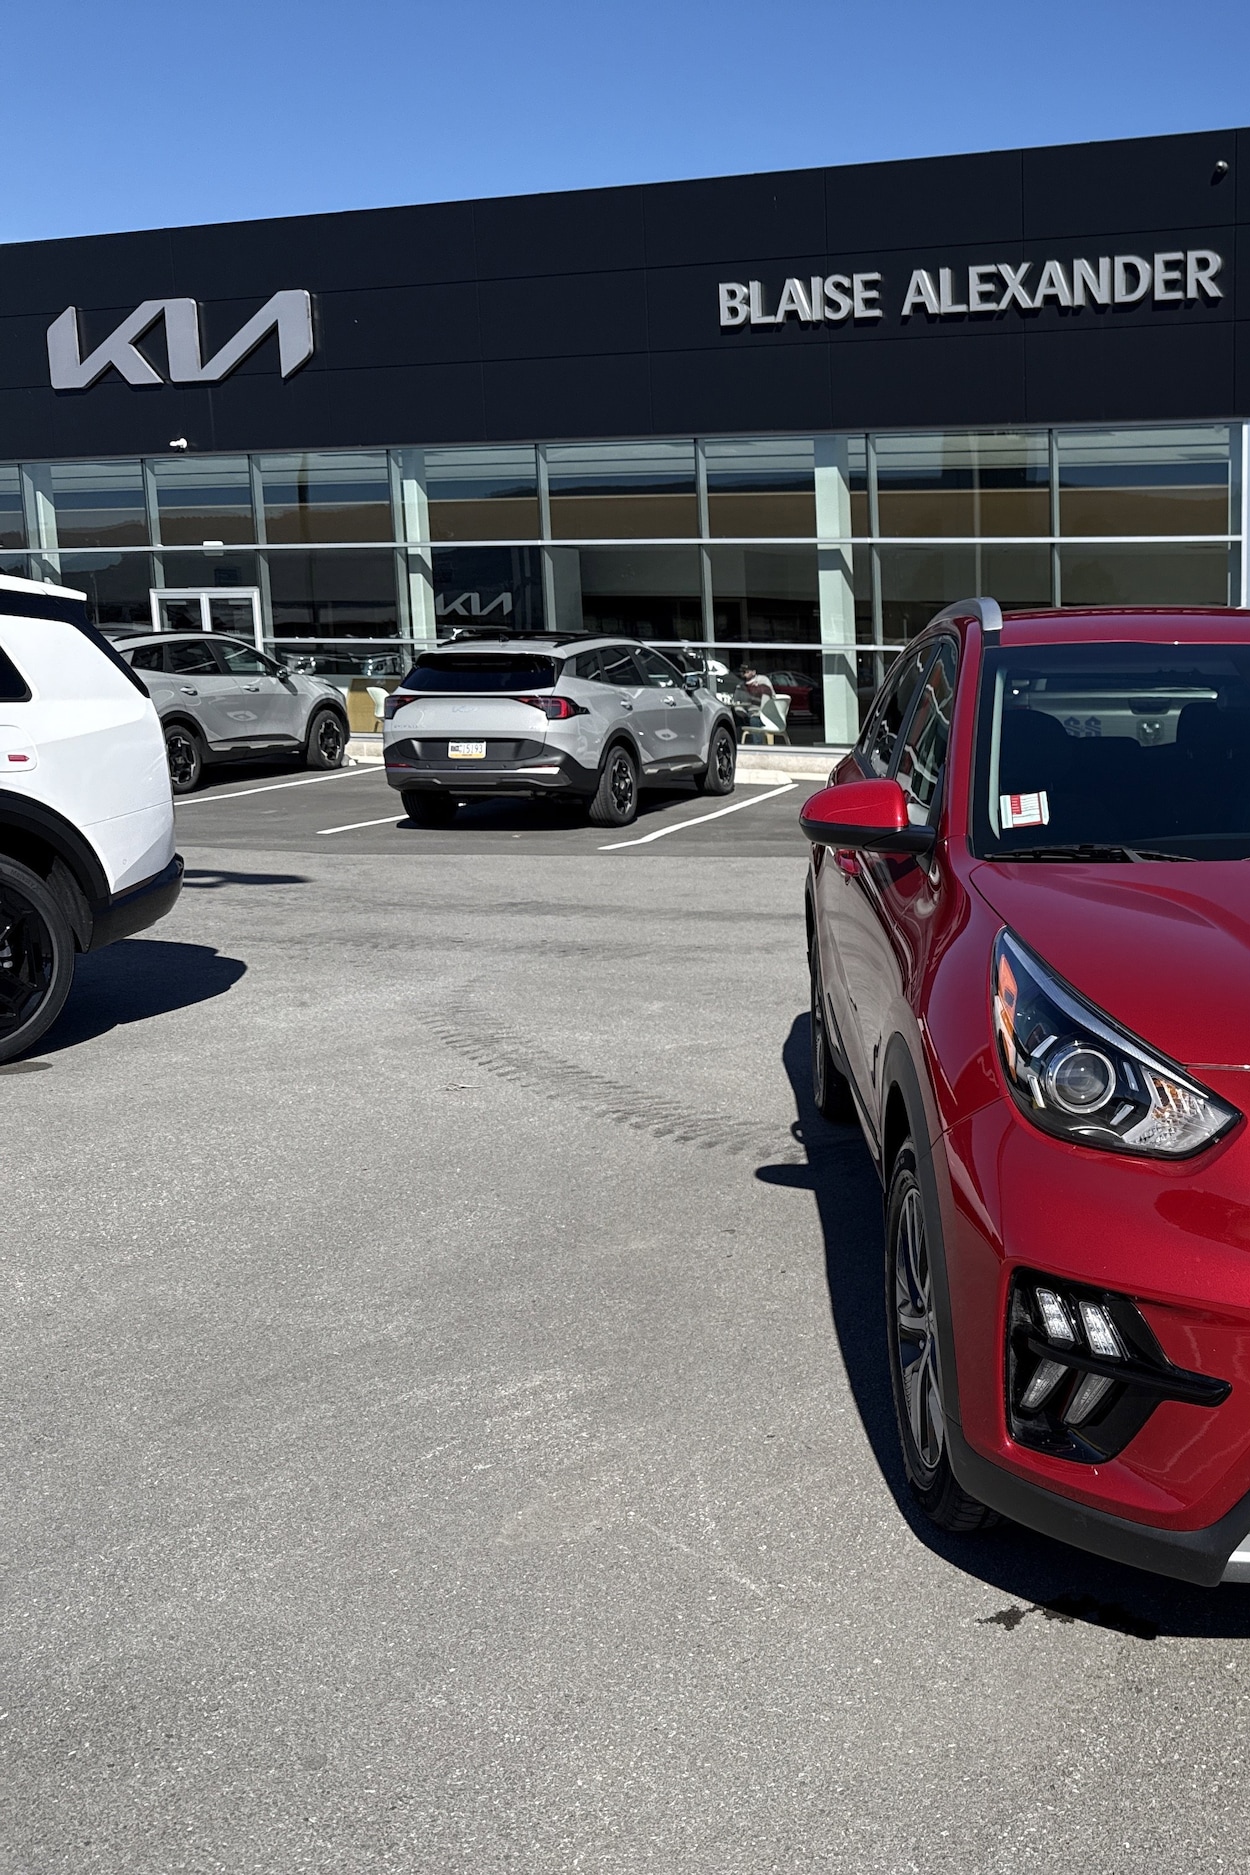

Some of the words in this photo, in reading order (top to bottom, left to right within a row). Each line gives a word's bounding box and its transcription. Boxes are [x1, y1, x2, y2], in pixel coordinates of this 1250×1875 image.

[718, 272, 884, 326] BLAISE
[901, 250, 1224, 316] ALEXANDER
[47, 289, 314, 390] KIA
[435, 592, 512, 615] KIA
